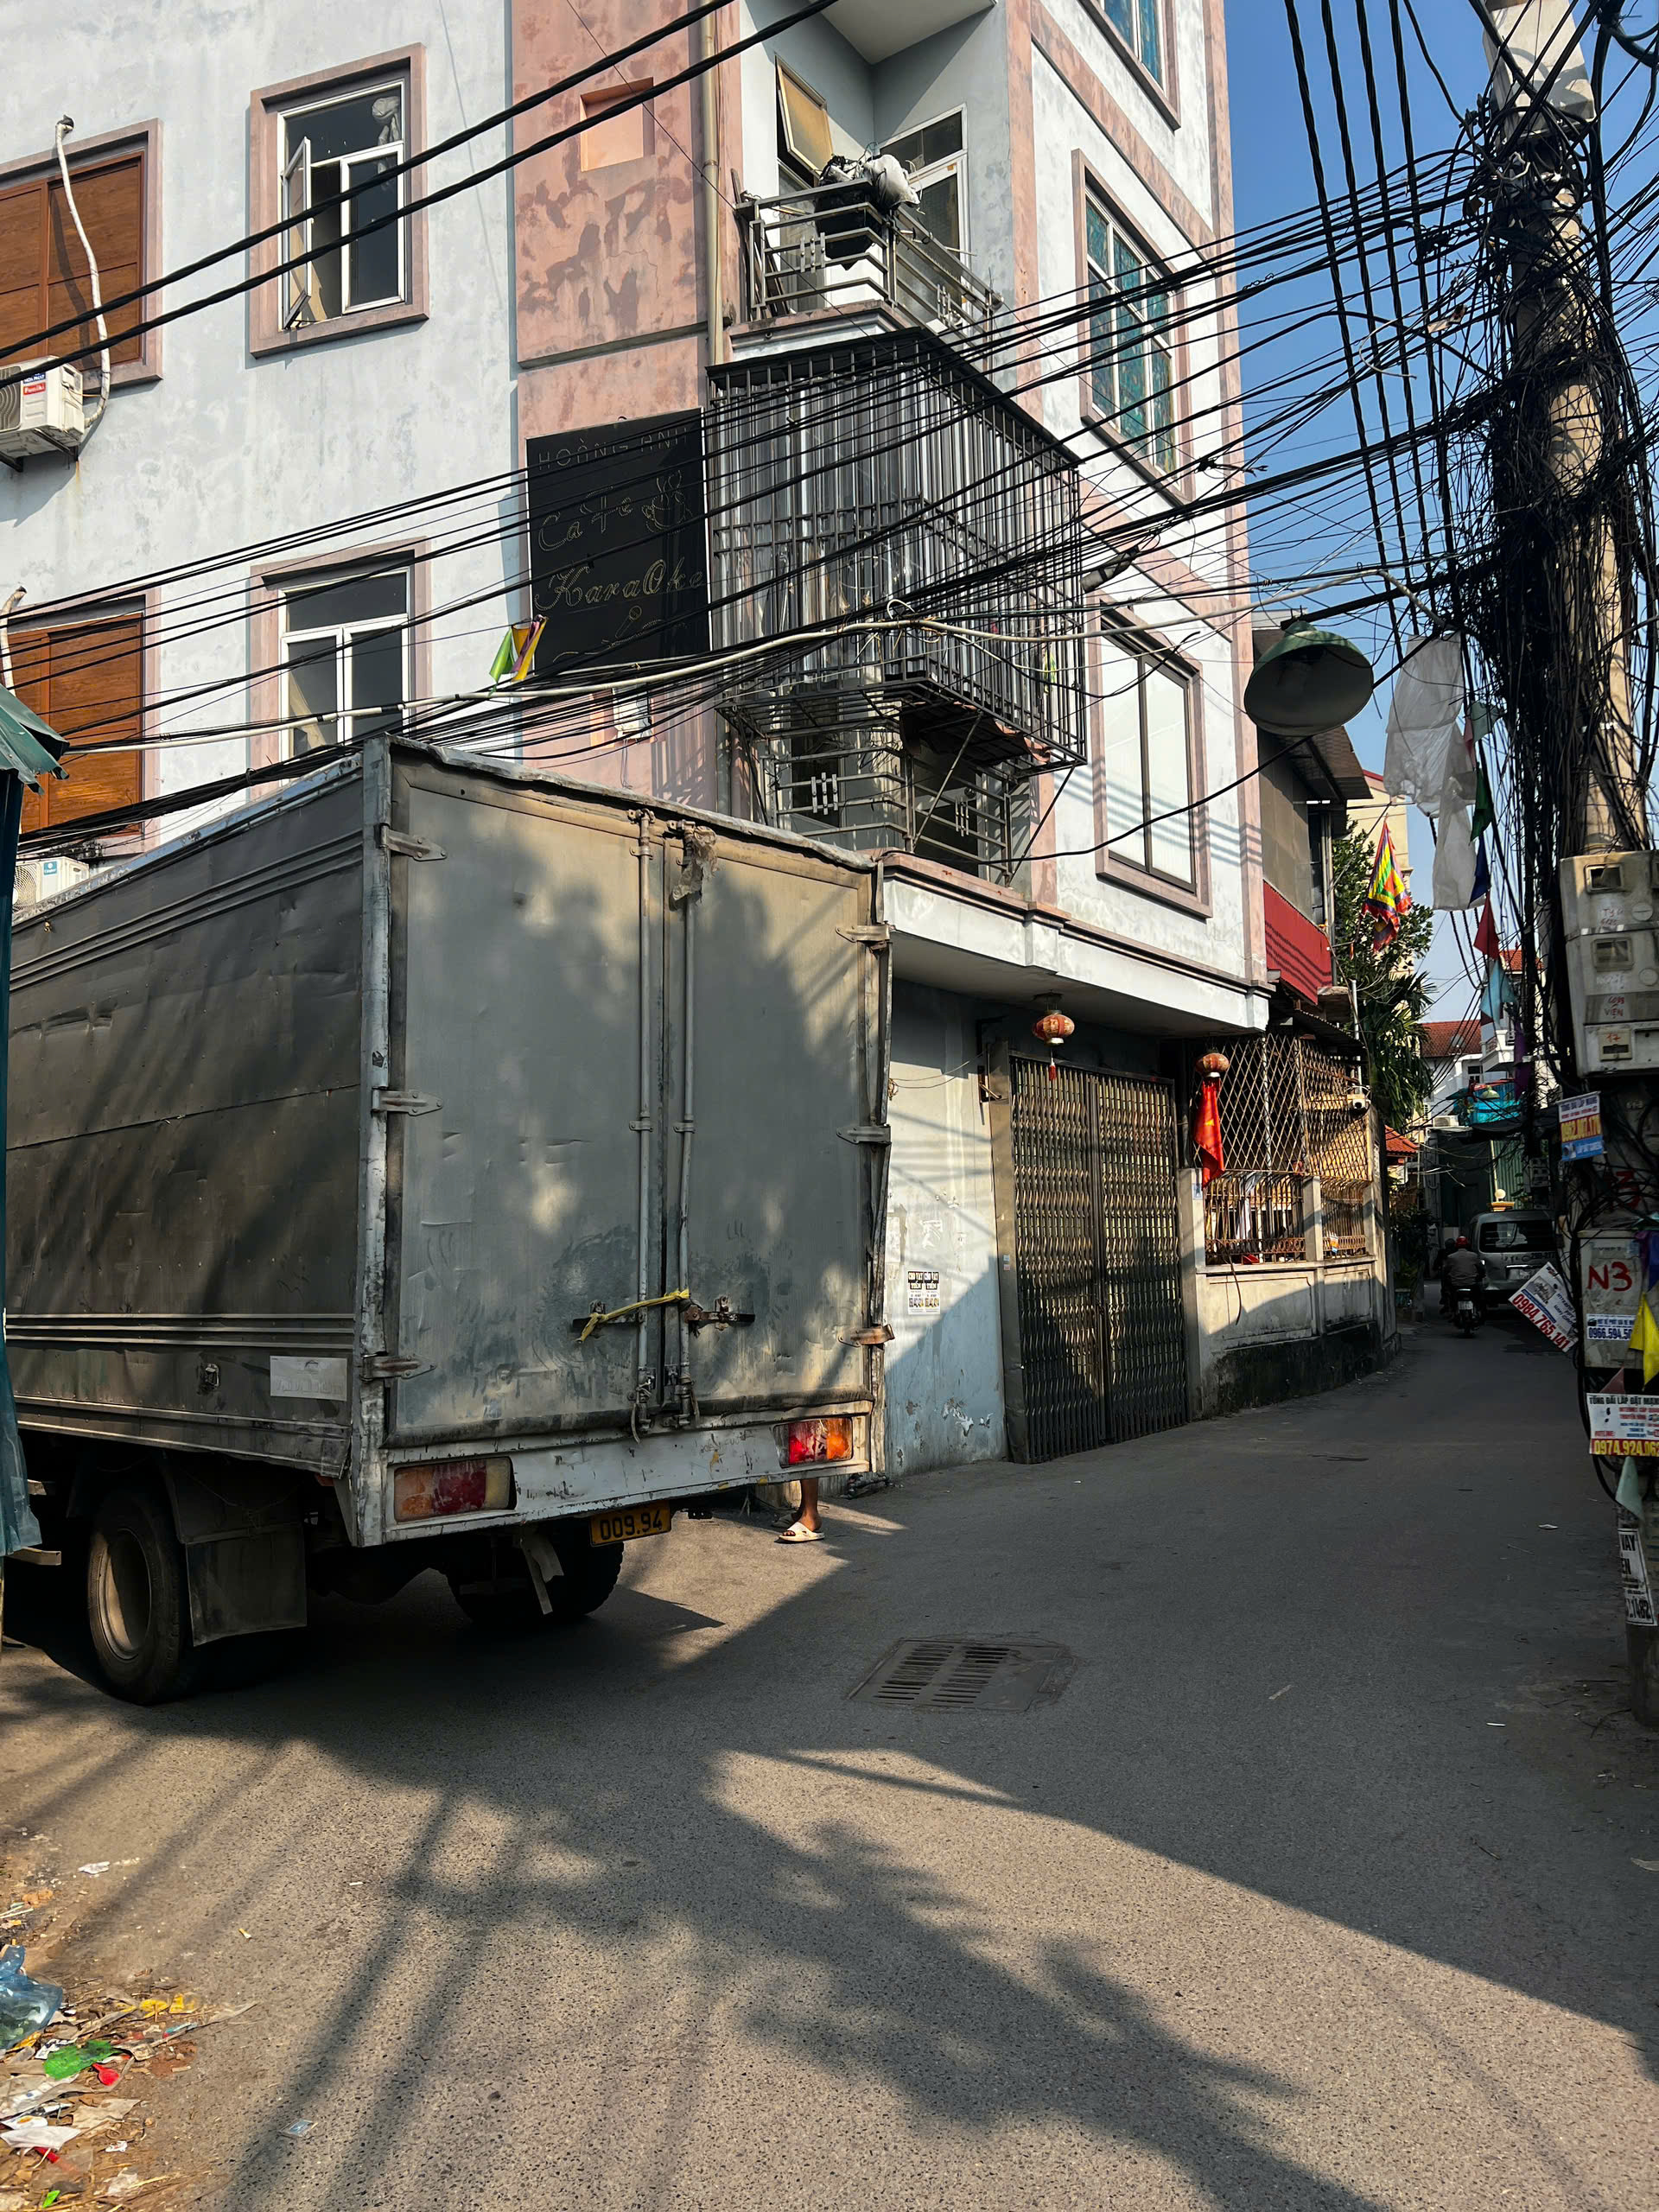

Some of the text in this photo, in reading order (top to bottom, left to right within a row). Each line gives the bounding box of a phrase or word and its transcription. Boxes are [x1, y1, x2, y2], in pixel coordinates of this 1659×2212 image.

[1587, 1261, 1633, 1293] N3
[1512, 1294, 1571, 1350] 0984.765.141
[600, 1509, 663, 1541] 009.94
